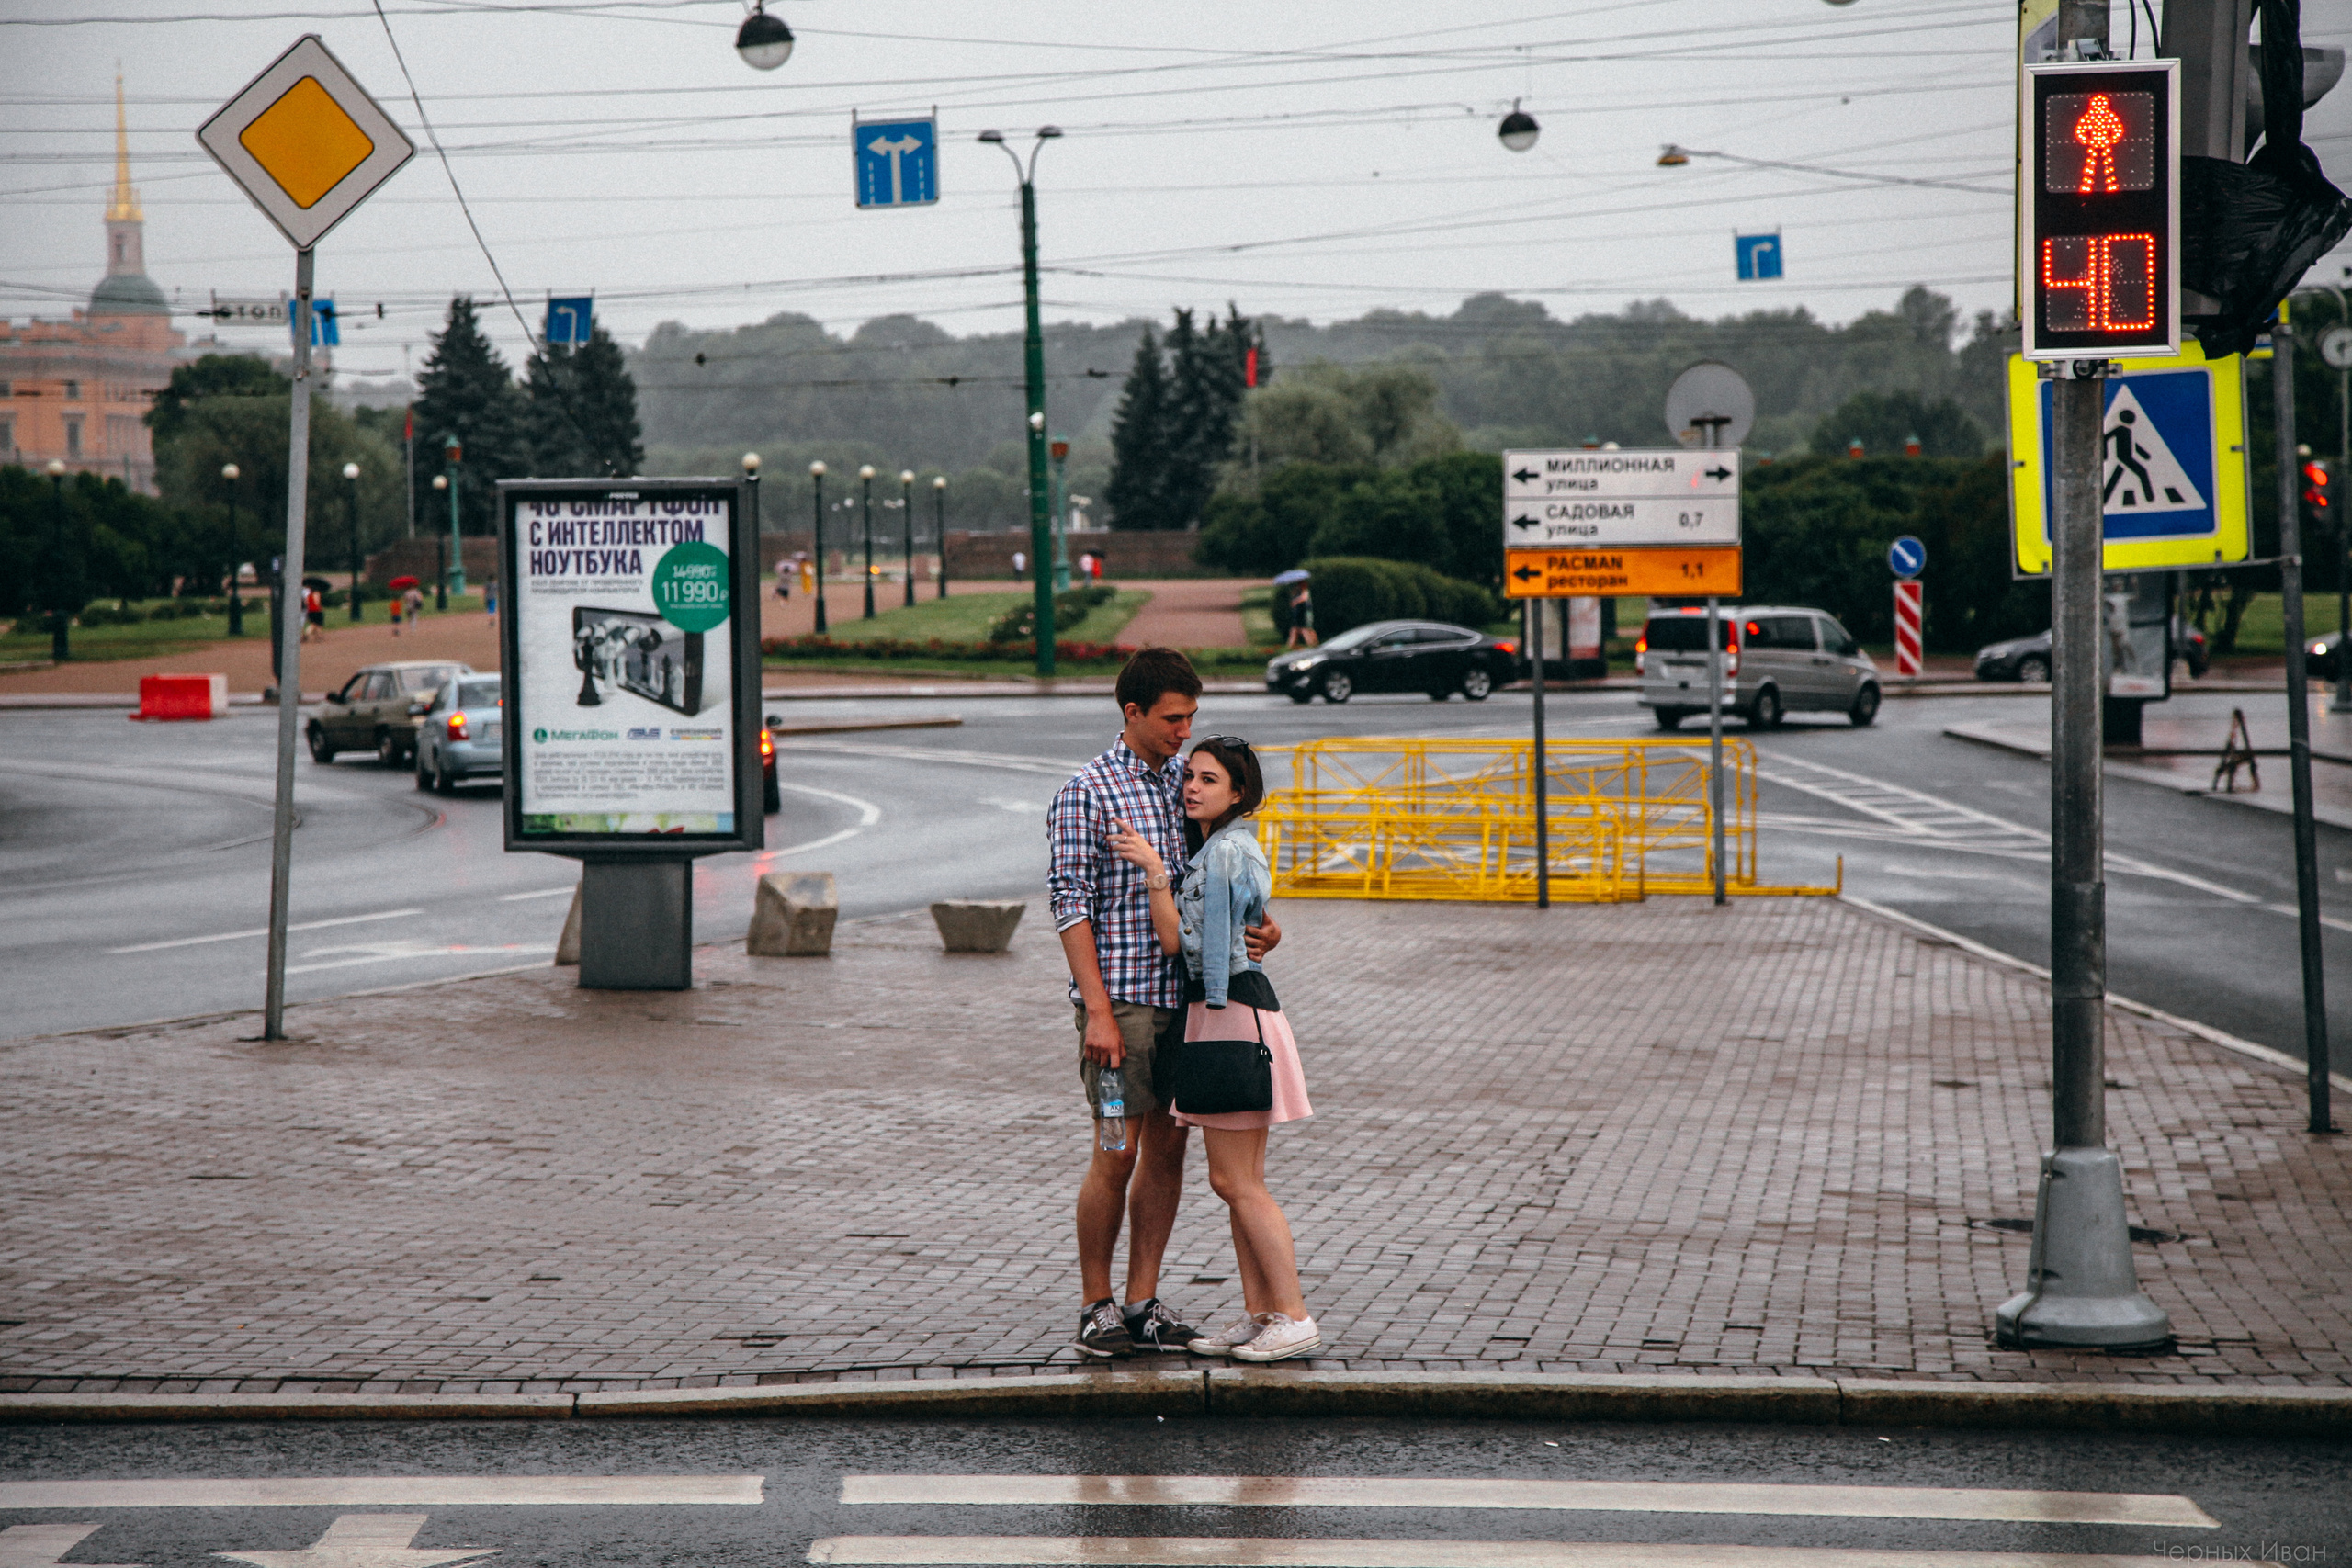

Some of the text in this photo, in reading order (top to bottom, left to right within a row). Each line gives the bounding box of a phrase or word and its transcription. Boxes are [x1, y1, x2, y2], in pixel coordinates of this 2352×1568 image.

[2044, 233, 2154, 331] 40
[1546, 458, 1675, 473] МИЛЛИОННАЯ
[1546, 479, 1599, 494] улица
[1545, 504, 1635, 520] САДОВАЯ
[1679, 512, 1704, 529] 0,7
[529, 519, 704, 547] С ИНТЕЛЛЕКТОМ
[1546, 525, 1599, 538] улица
[530, 549, 643, 575] НОУТБУКА
[1681, 561, 1704, 581] 1,1
[1547, 575, 1628, 590] ресторан
